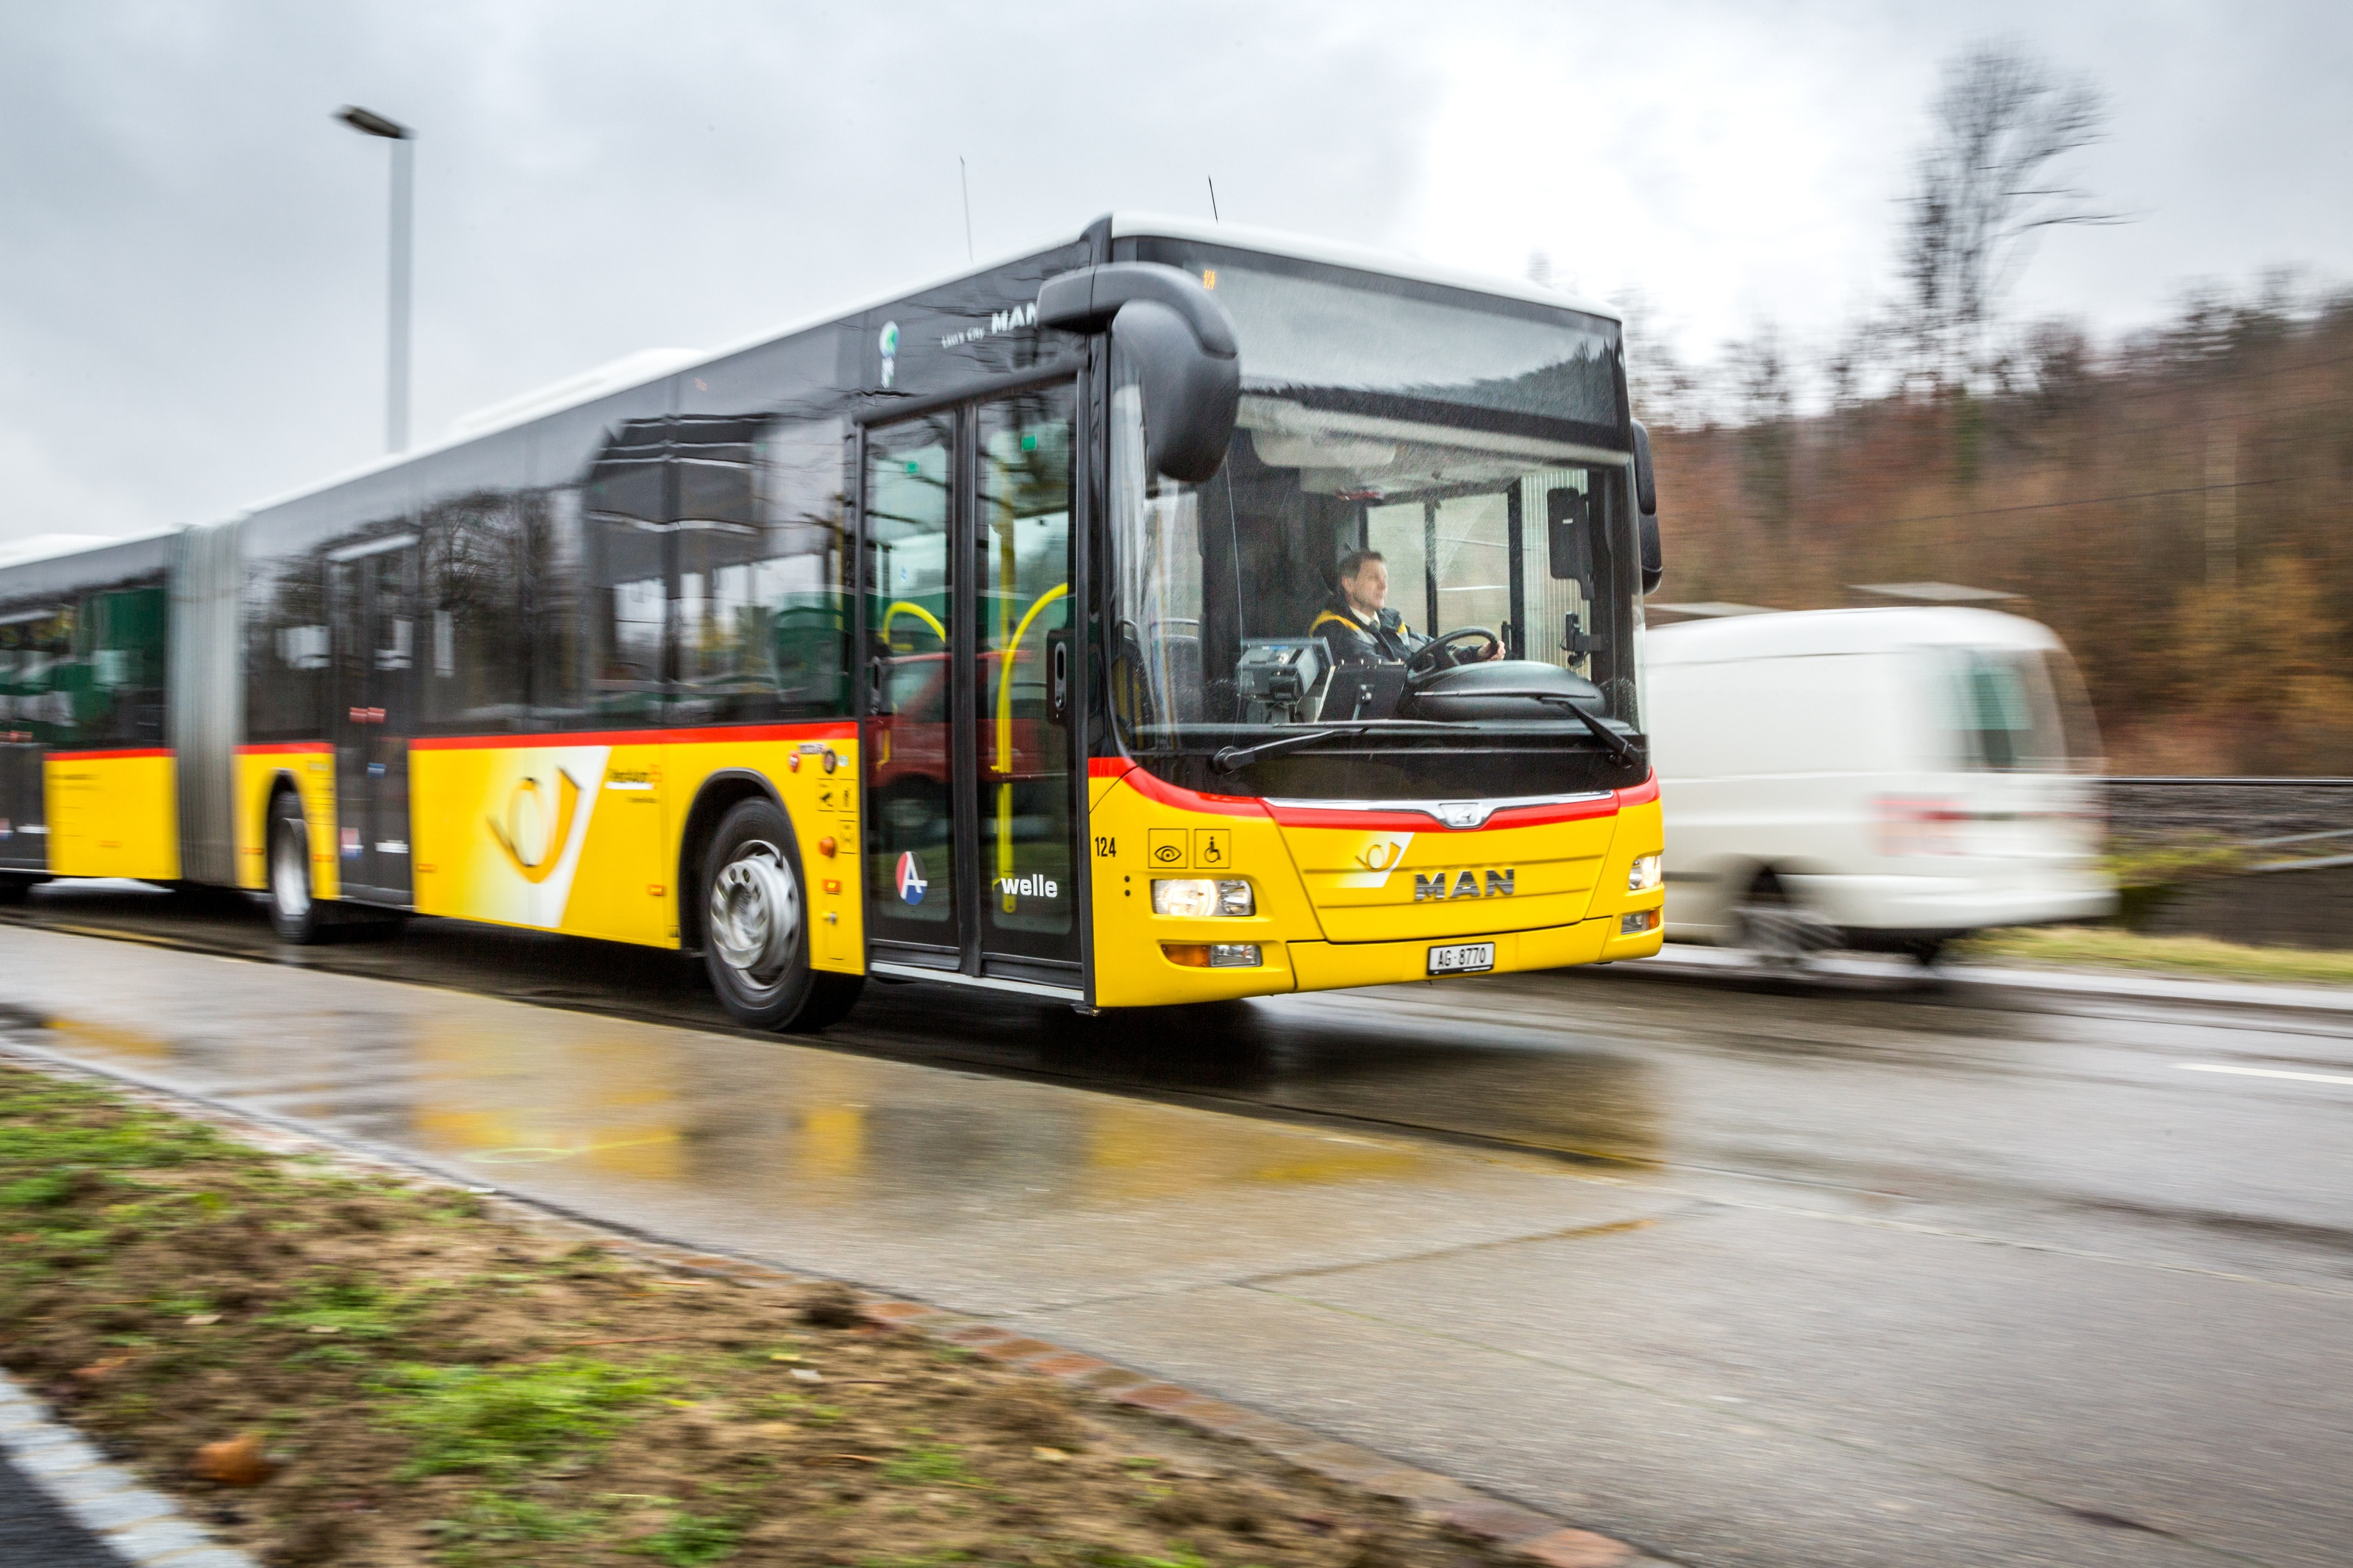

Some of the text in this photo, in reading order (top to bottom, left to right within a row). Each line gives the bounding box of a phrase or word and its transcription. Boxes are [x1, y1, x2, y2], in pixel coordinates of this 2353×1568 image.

[1095, 837, 1116, 857] 124
[1001, 873, 1058, 898] welle
[1414, 868, 1515, 901] MAN
